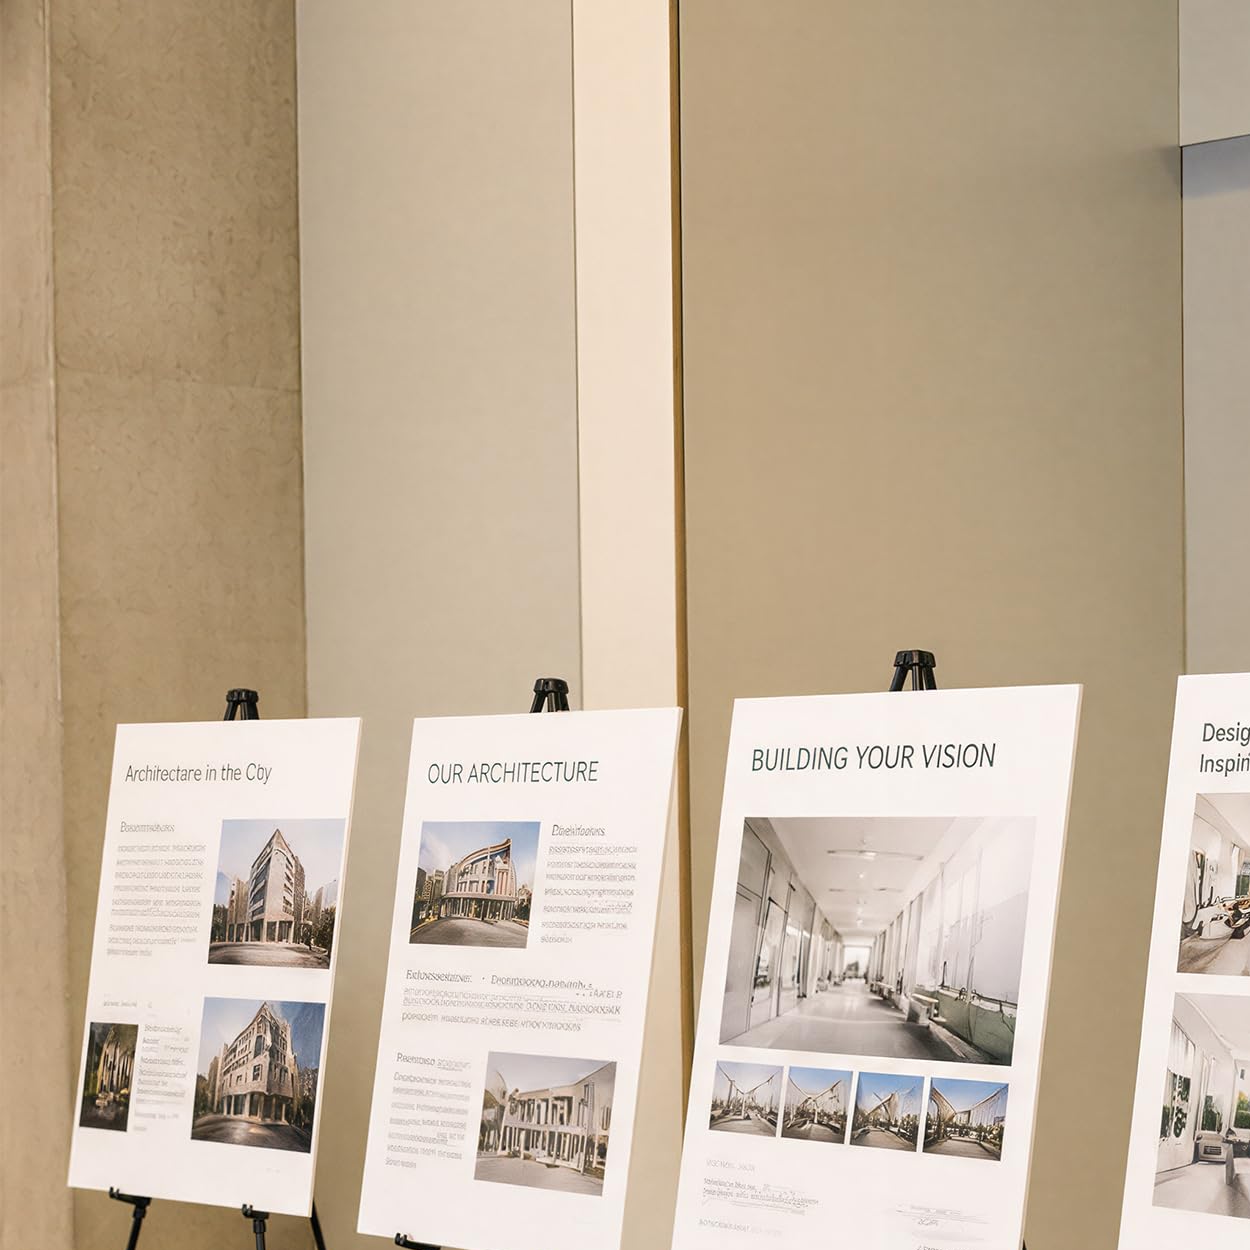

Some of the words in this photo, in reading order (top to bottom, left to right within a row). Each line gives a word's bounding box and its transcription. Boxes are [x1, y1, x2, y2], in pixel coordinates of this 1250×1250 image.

[751, 746, 849, 772] BUILDING
[855, 744, 915, 770] YOUR
[921, 742, 997, 769] VISION
[205, 764, 217, 782] in
[220, 762, 242, 782] the
[427, 762, 464, 785] OUR
[466, 760, 600, 785] ARCHITECTURE
